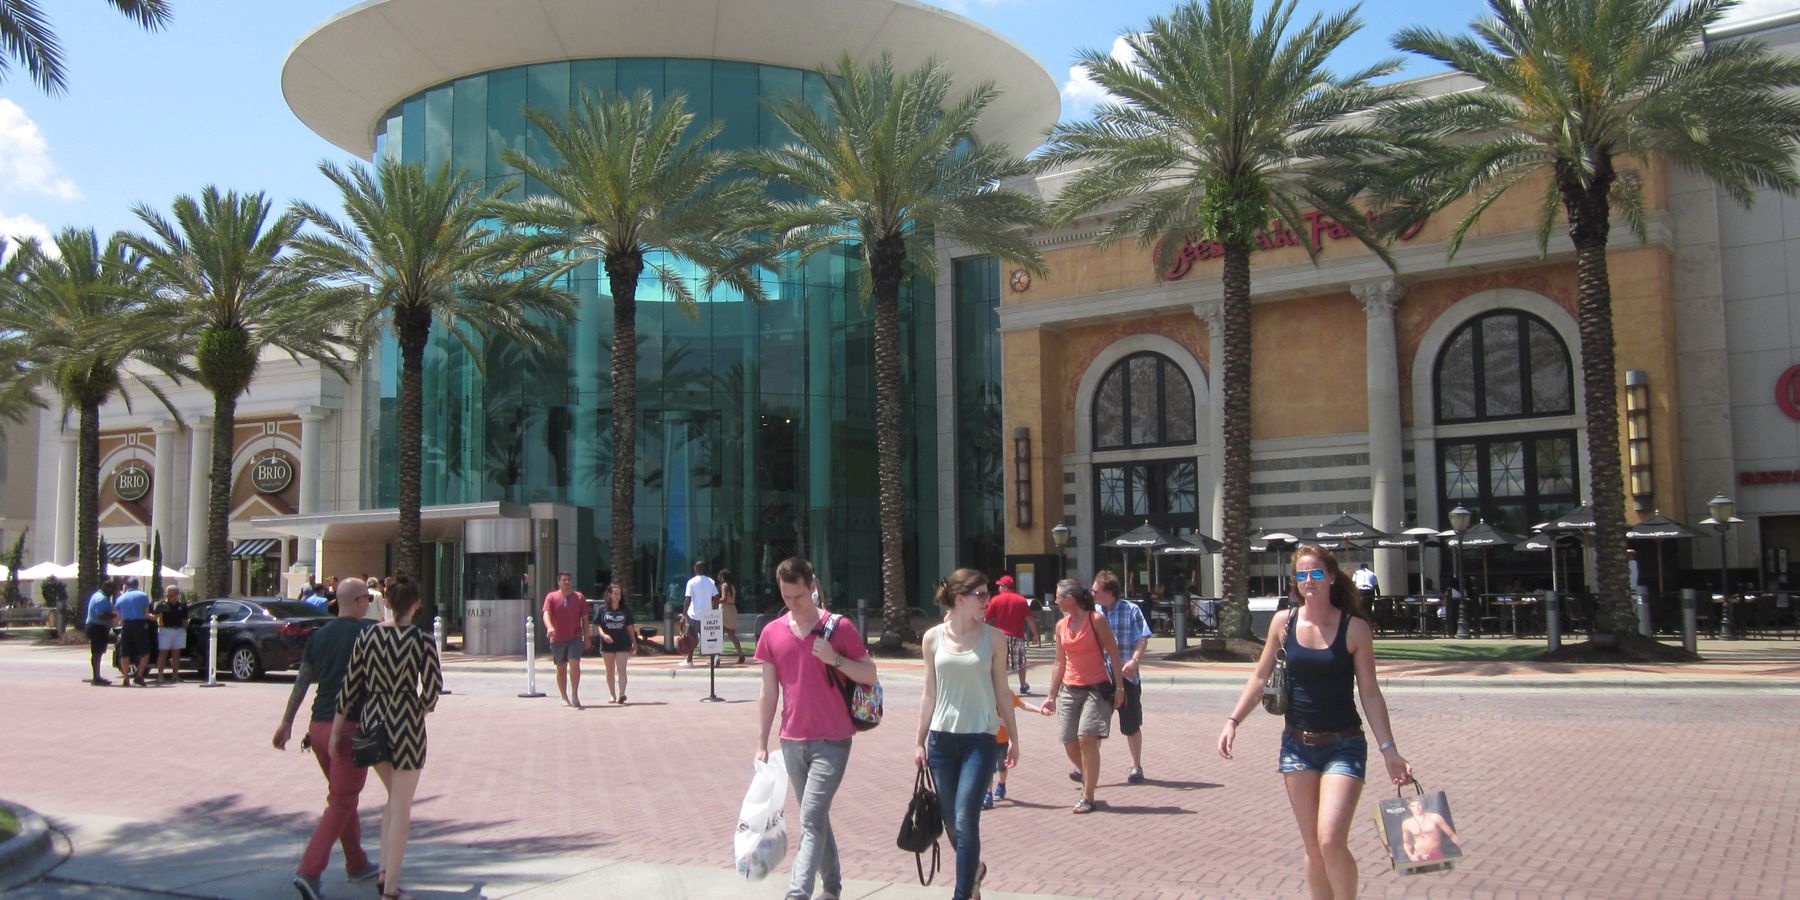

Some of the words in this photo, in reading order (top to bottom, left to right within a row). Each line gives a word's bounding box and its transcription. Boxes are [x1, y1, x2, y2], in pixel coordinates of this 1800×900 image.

[258, 465, 286, 480] BRIO
[120, 474, 144, 489] BRIO
[466, 607, 493, 617] VALET
